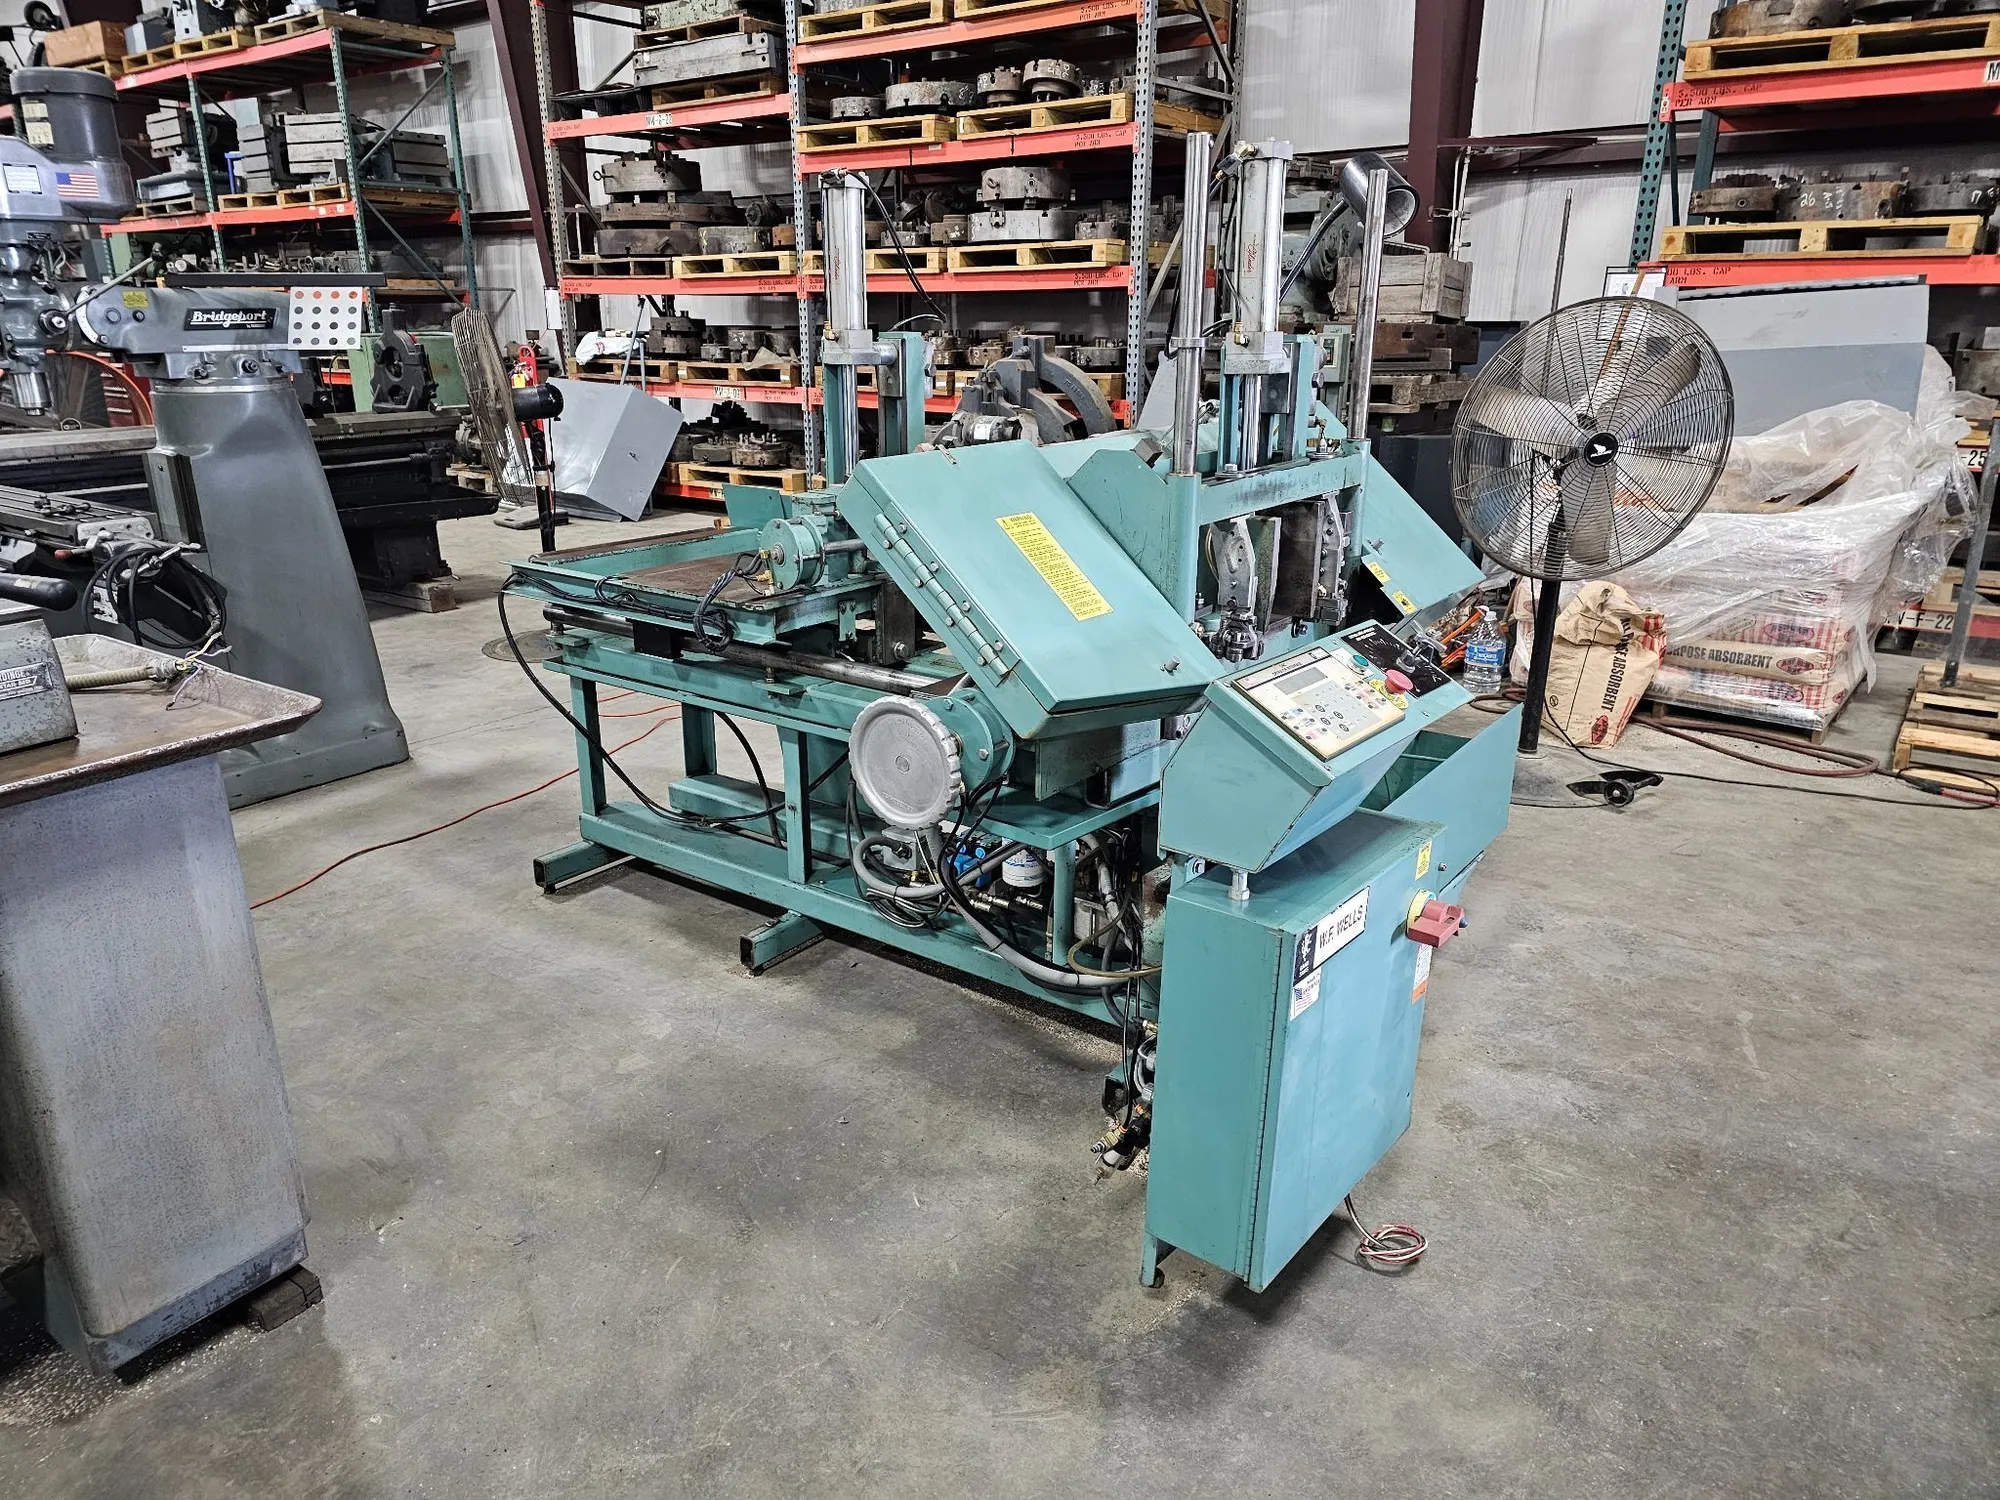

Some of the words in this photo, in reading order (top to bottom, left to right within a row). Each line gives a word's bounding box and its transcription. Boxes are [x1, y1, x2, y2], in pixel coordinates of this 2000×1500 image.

[1713, 266, 1732, 275] CAP
[1669, 276, 1688, 285] ARM
[191, 310, 267, 328] Bridgeport
[1708, 648, 1773, 669] ABSORBENT
[1601, 656, 1627, 712] ABSORBENT
[1337, 904, 1363, 936] WELLS
